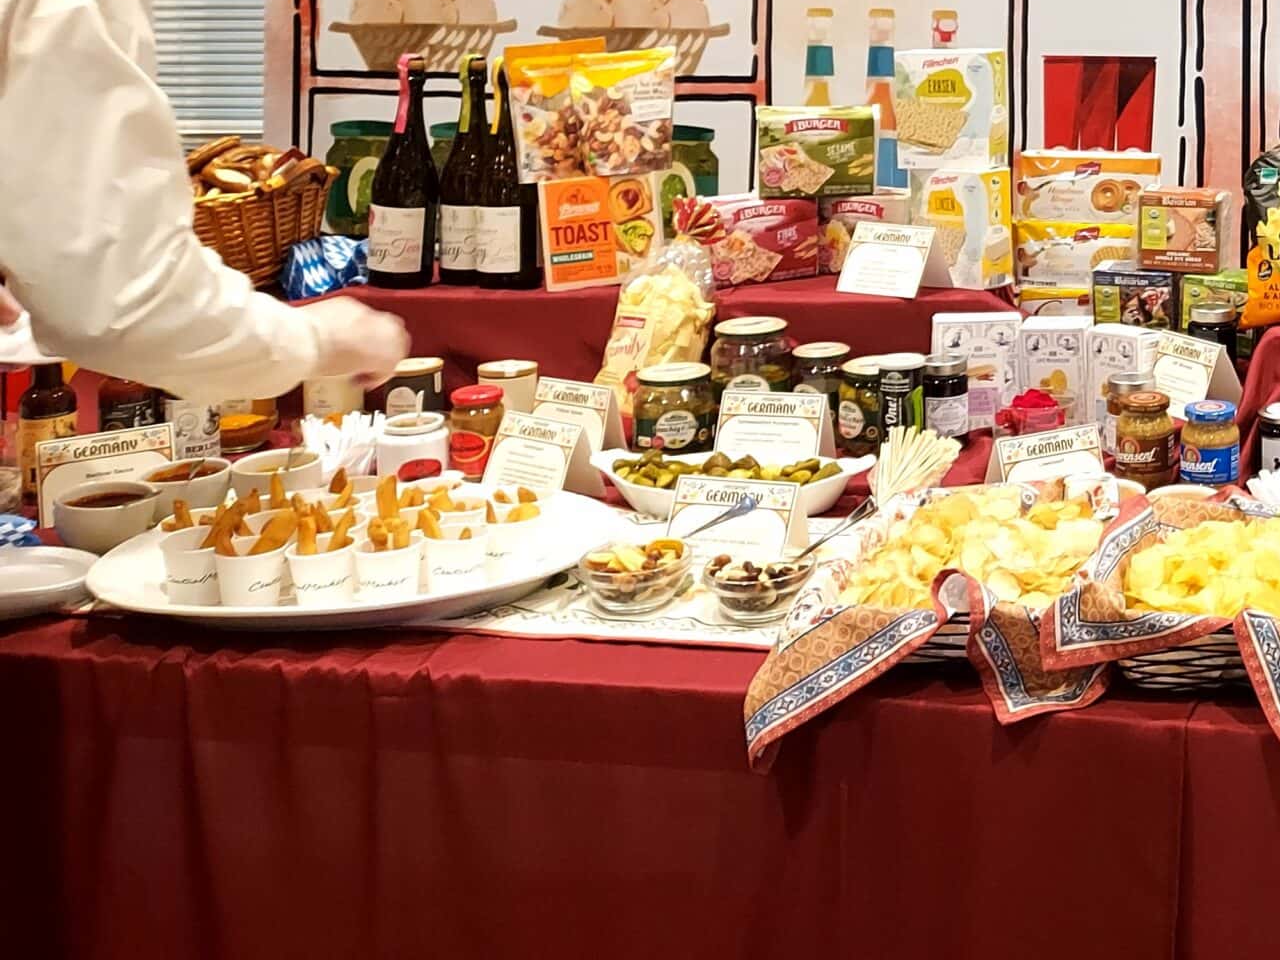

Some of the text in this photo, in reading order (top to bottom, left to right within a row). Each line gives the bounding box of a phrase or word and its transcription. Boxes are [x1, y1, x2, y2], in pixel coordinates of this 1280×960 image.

[551, 221, 611, 247] TOAST
[747, 401, 797, 415] GERMANY
[73, 439, 139, 459] GERMANY
[1026, 438, 1075, 457] GERMANY
[705, 489, 764, 505] GERMY
